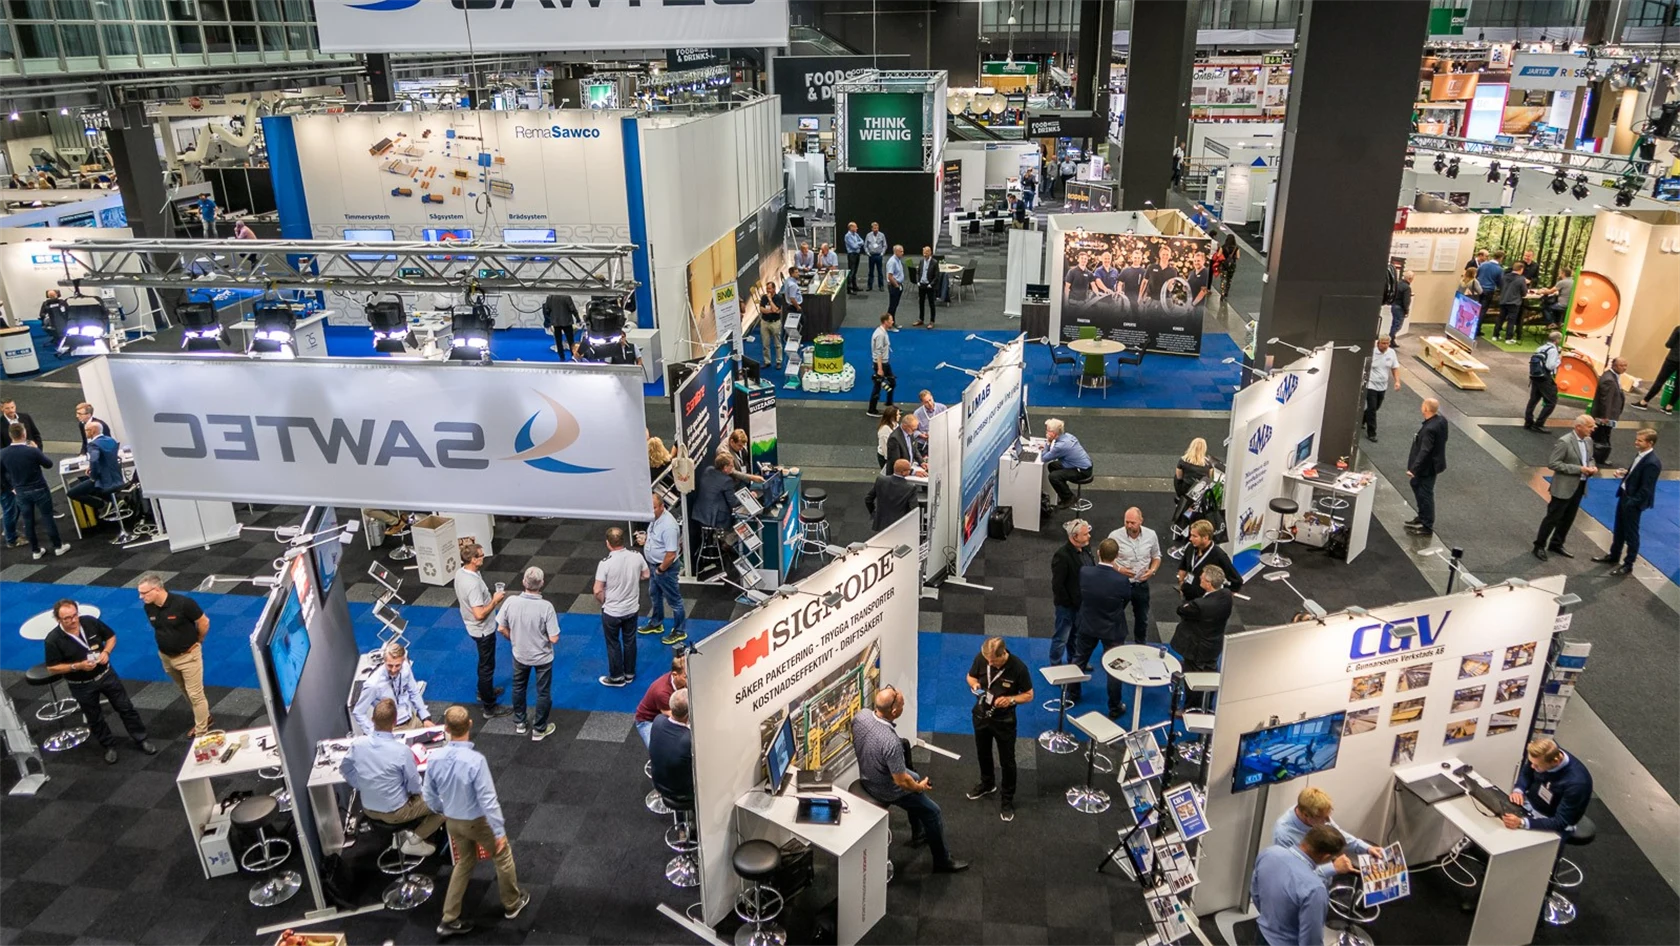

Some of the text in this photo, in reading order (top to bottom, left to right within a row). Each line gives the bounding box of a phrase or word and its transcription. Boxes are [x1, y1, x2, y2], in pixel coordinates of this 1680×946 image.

[804, 70, 845, 87] FOOD
[807, 86, 818, 101] &
[863, 117, 906, 129] THINK
[1031, 121, 1048, 129] FOOD
[1038, 126, 1061, 134] DRINKS
[514, 125, 600, 139] RemaSawco
[859, 129, 911, 141] WEINIG
[344, 213, 391, 221] Timmersystem
[429, 213, 464, 221] Sågsystem
[508, 213, 548, 221] Brädsystem
[1405, 226, 1458, 235] PERFORMANCE
[1458, 227, 1470, 235] 2.0
[749, 398, 776, 413] BUZZARD
[967, 383, 992, 420] LIMAB
[771, 550, 894, 652] SIGNODE
[1349, 609, 1453, 661] CGV
[734, 678, 764, 705] SÄKER
[765, 643, 814, 686] PAKETERING
[820, 621, 849, 647] TRYGGA
[850, 587, 895, 626] TRANSPORTER
[752, 646, 834, 712] KOSTNADSEFFEKTIVT
[840, 611, 884, 652] DRIFTSÄKERT
[1355, 656, 1399, 672] Gunnarssons
[1400, 650, 1432, 664] Verkstads
[1432, 647, 1445, 657] AB
